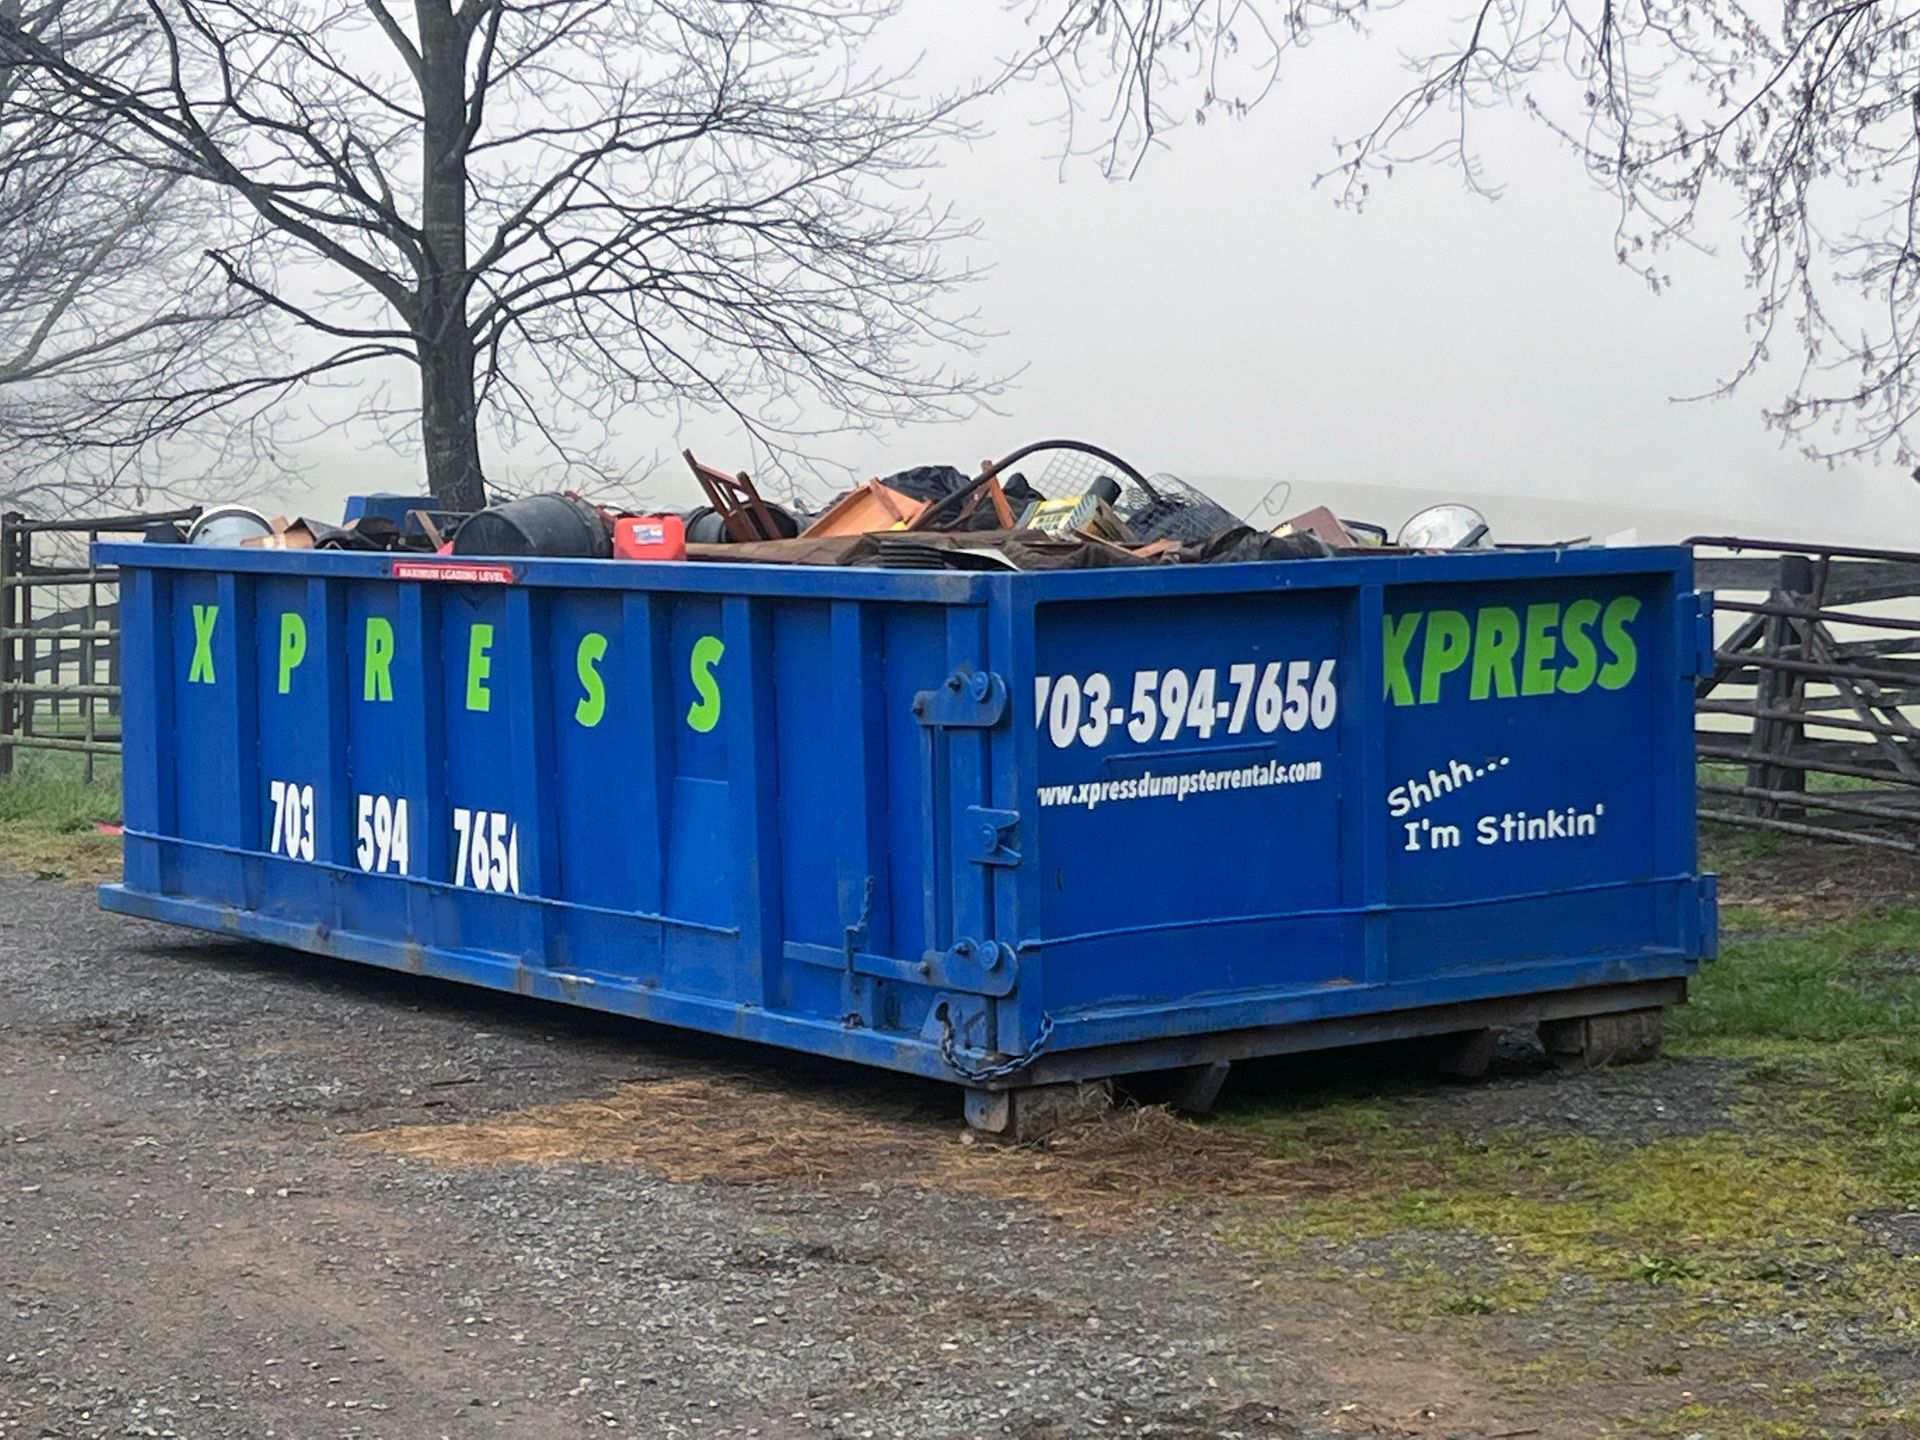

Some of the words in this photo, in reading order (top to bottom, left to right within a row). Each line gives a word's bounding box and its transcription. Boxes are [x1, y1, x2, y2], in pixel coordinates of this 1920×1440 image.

[399, 568, 439, 579] MAXIMUM
[440, 569, 478, 581] LOADING
[478, 571, 508, 582] LEVEL
[1382, 597, 1642, 706] XPRESS
[270, 780, 315, 863] 703
[356, 794, 409, 876] 594
[1404, 818, 1460, 851] I'm
[1476, 803, 1604, 845] Stinkin'
